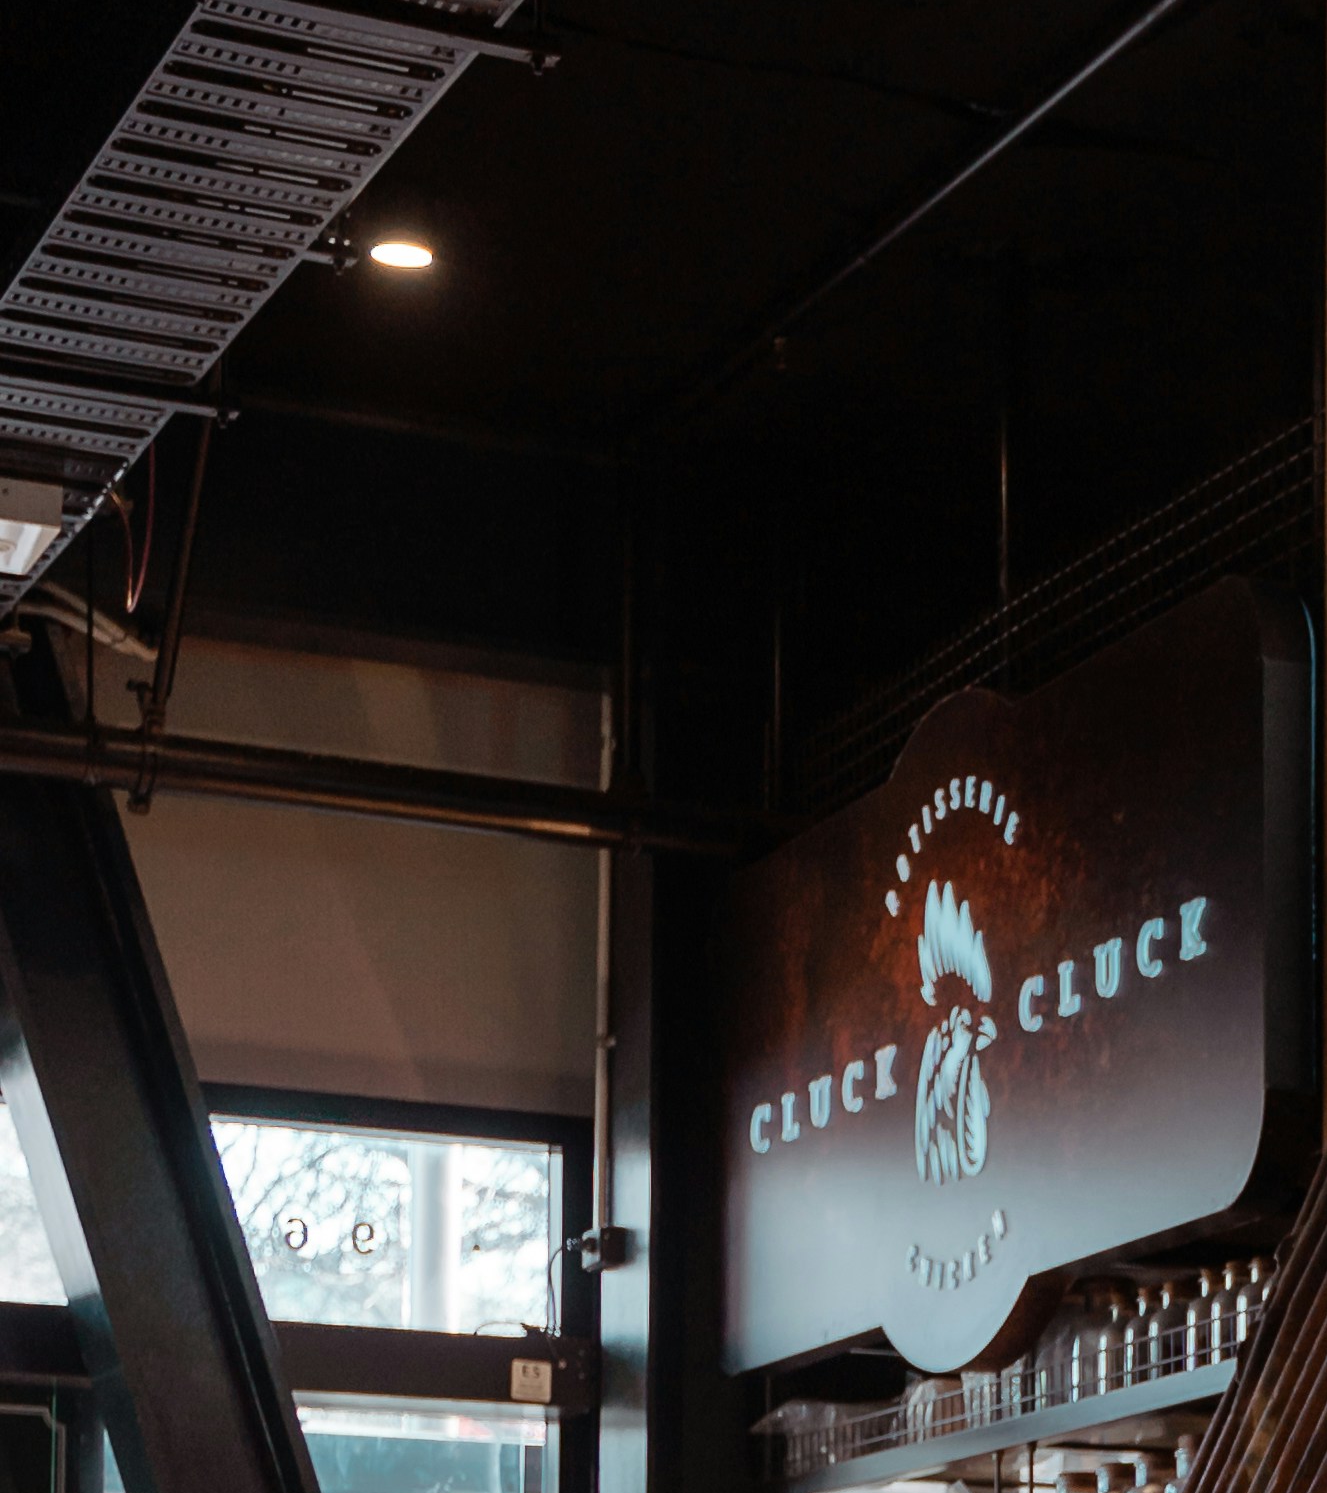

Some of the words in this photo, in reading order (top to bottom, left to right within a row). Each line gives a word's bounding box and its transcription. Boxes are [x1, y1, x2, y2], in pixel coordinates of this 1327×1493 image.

[1018, 896, 1207, 1032] CLUCK
[750, 1045, 897, 1153] CLUCK
[906, 1208, 1008, 1290] CHICKEN
